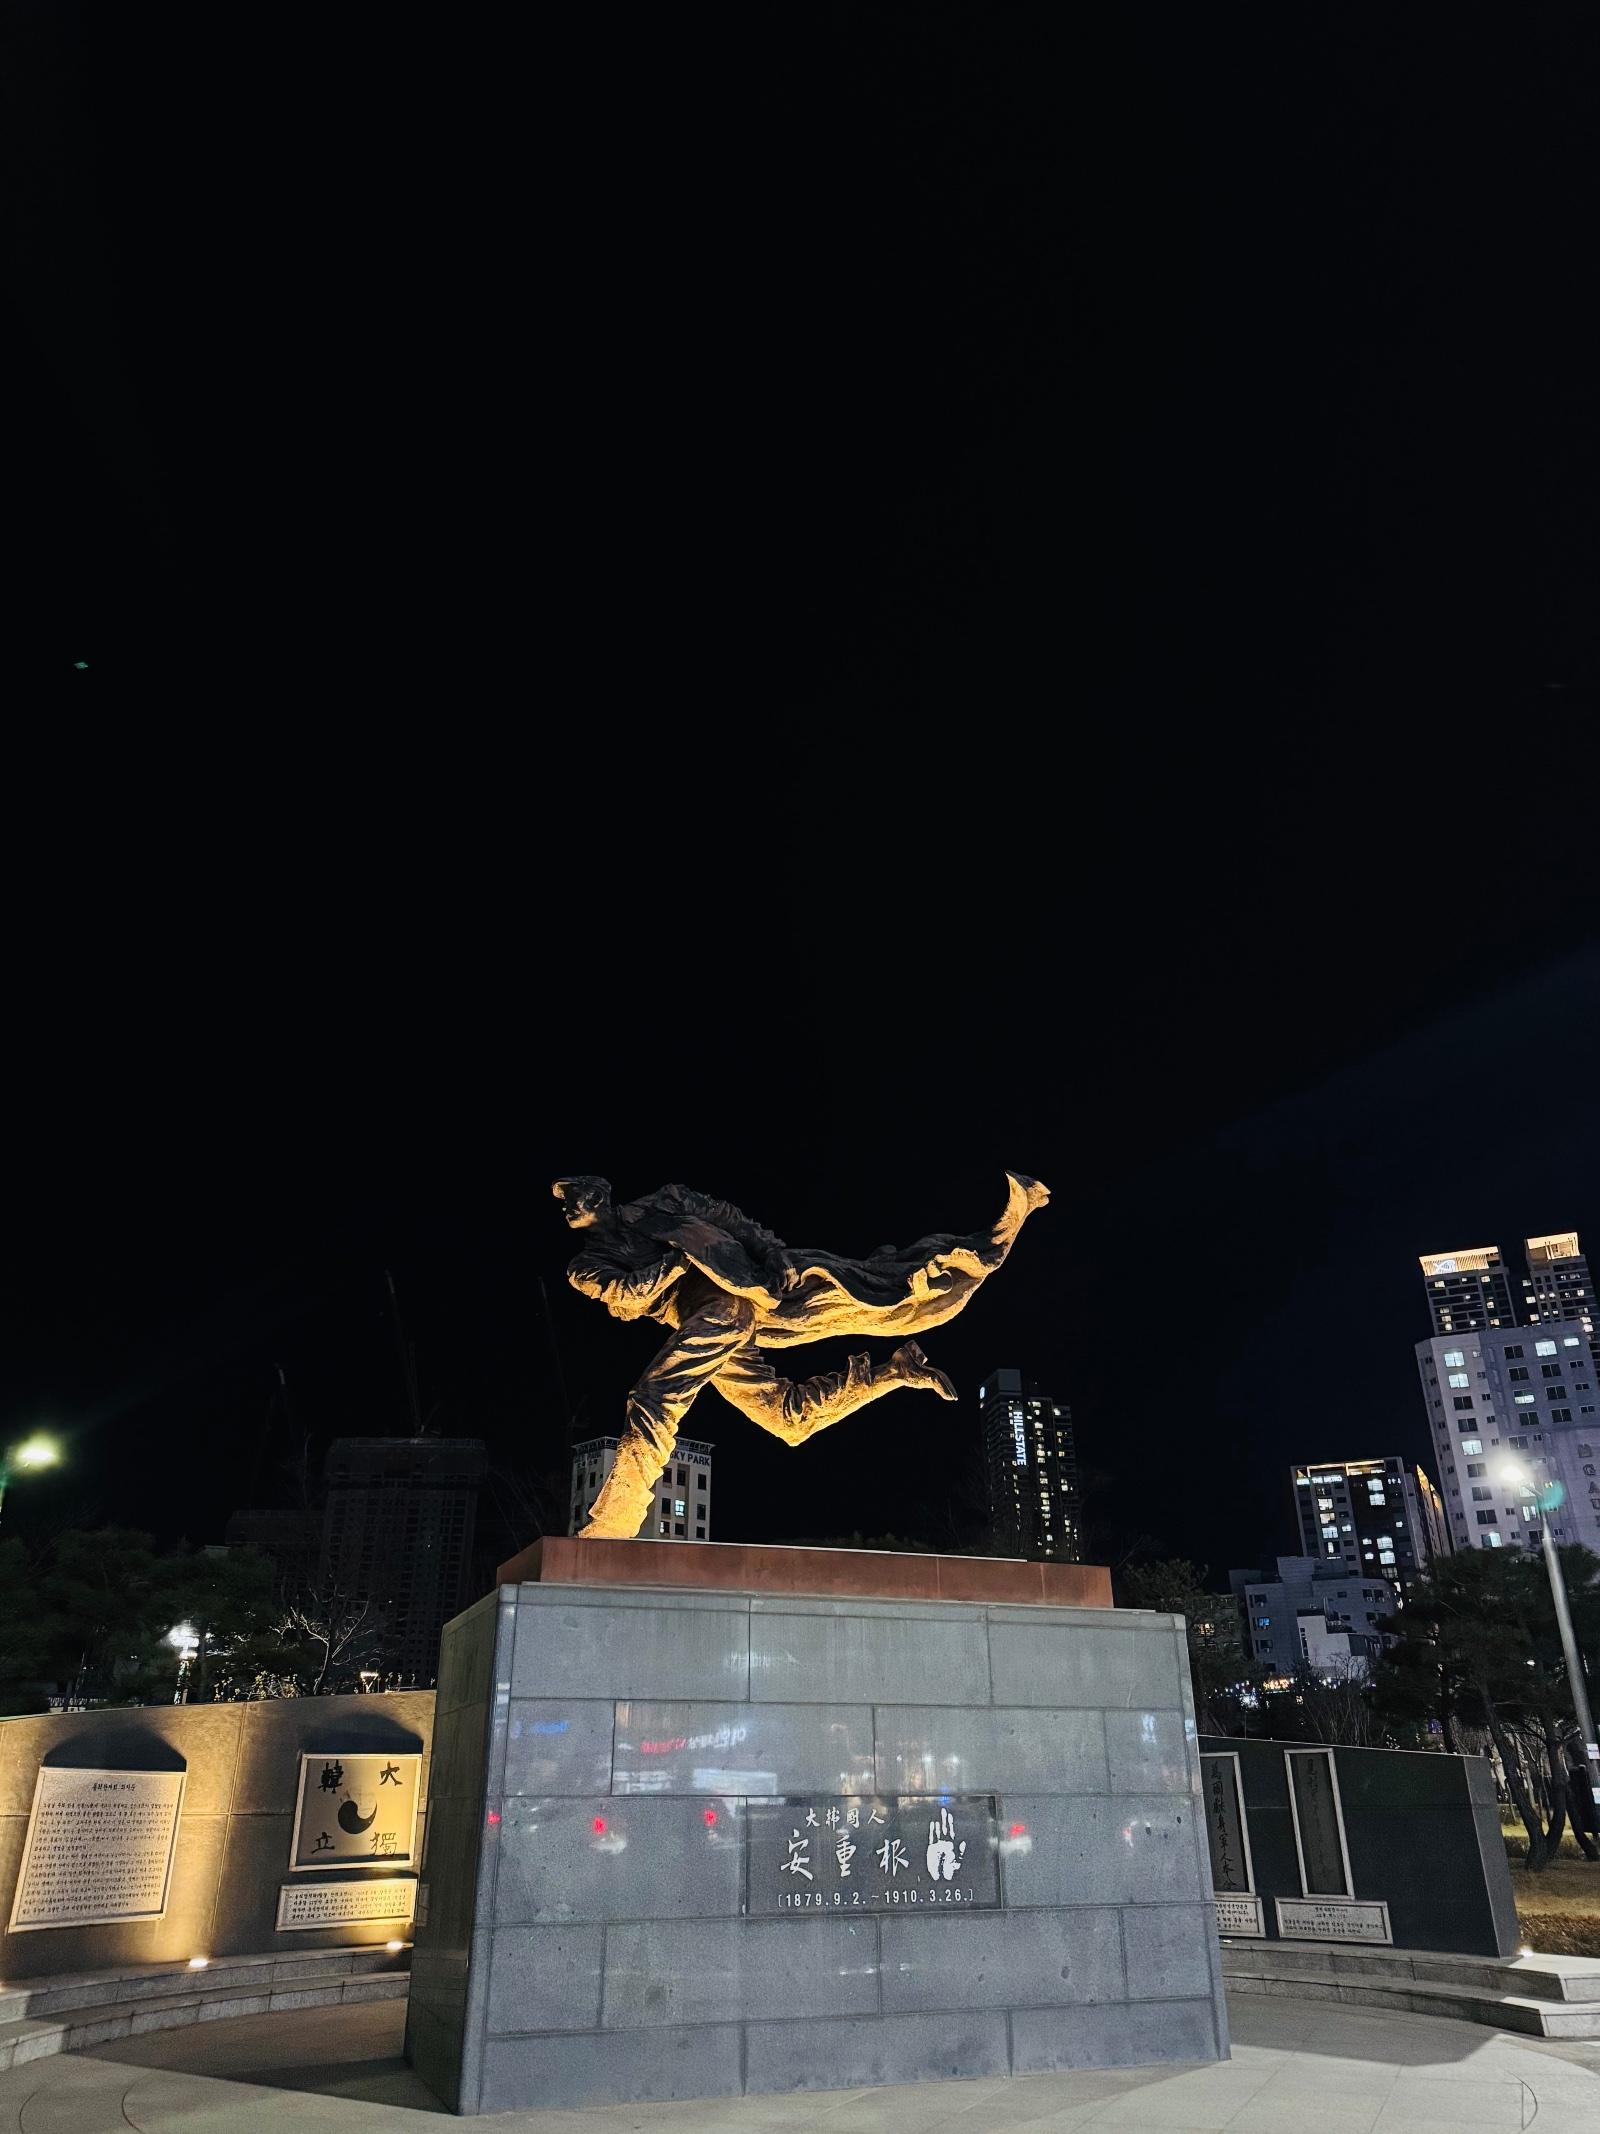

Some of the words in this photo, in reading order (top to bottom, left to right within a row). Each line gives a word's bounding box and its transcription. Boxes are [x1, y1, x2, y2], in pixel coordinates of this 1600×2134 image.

[687, 1453, 710, 1466] PARK
[1013, 1411, 1027, 1466] HILLSTATE
[780, 1828, 910, 1881] 安重根
